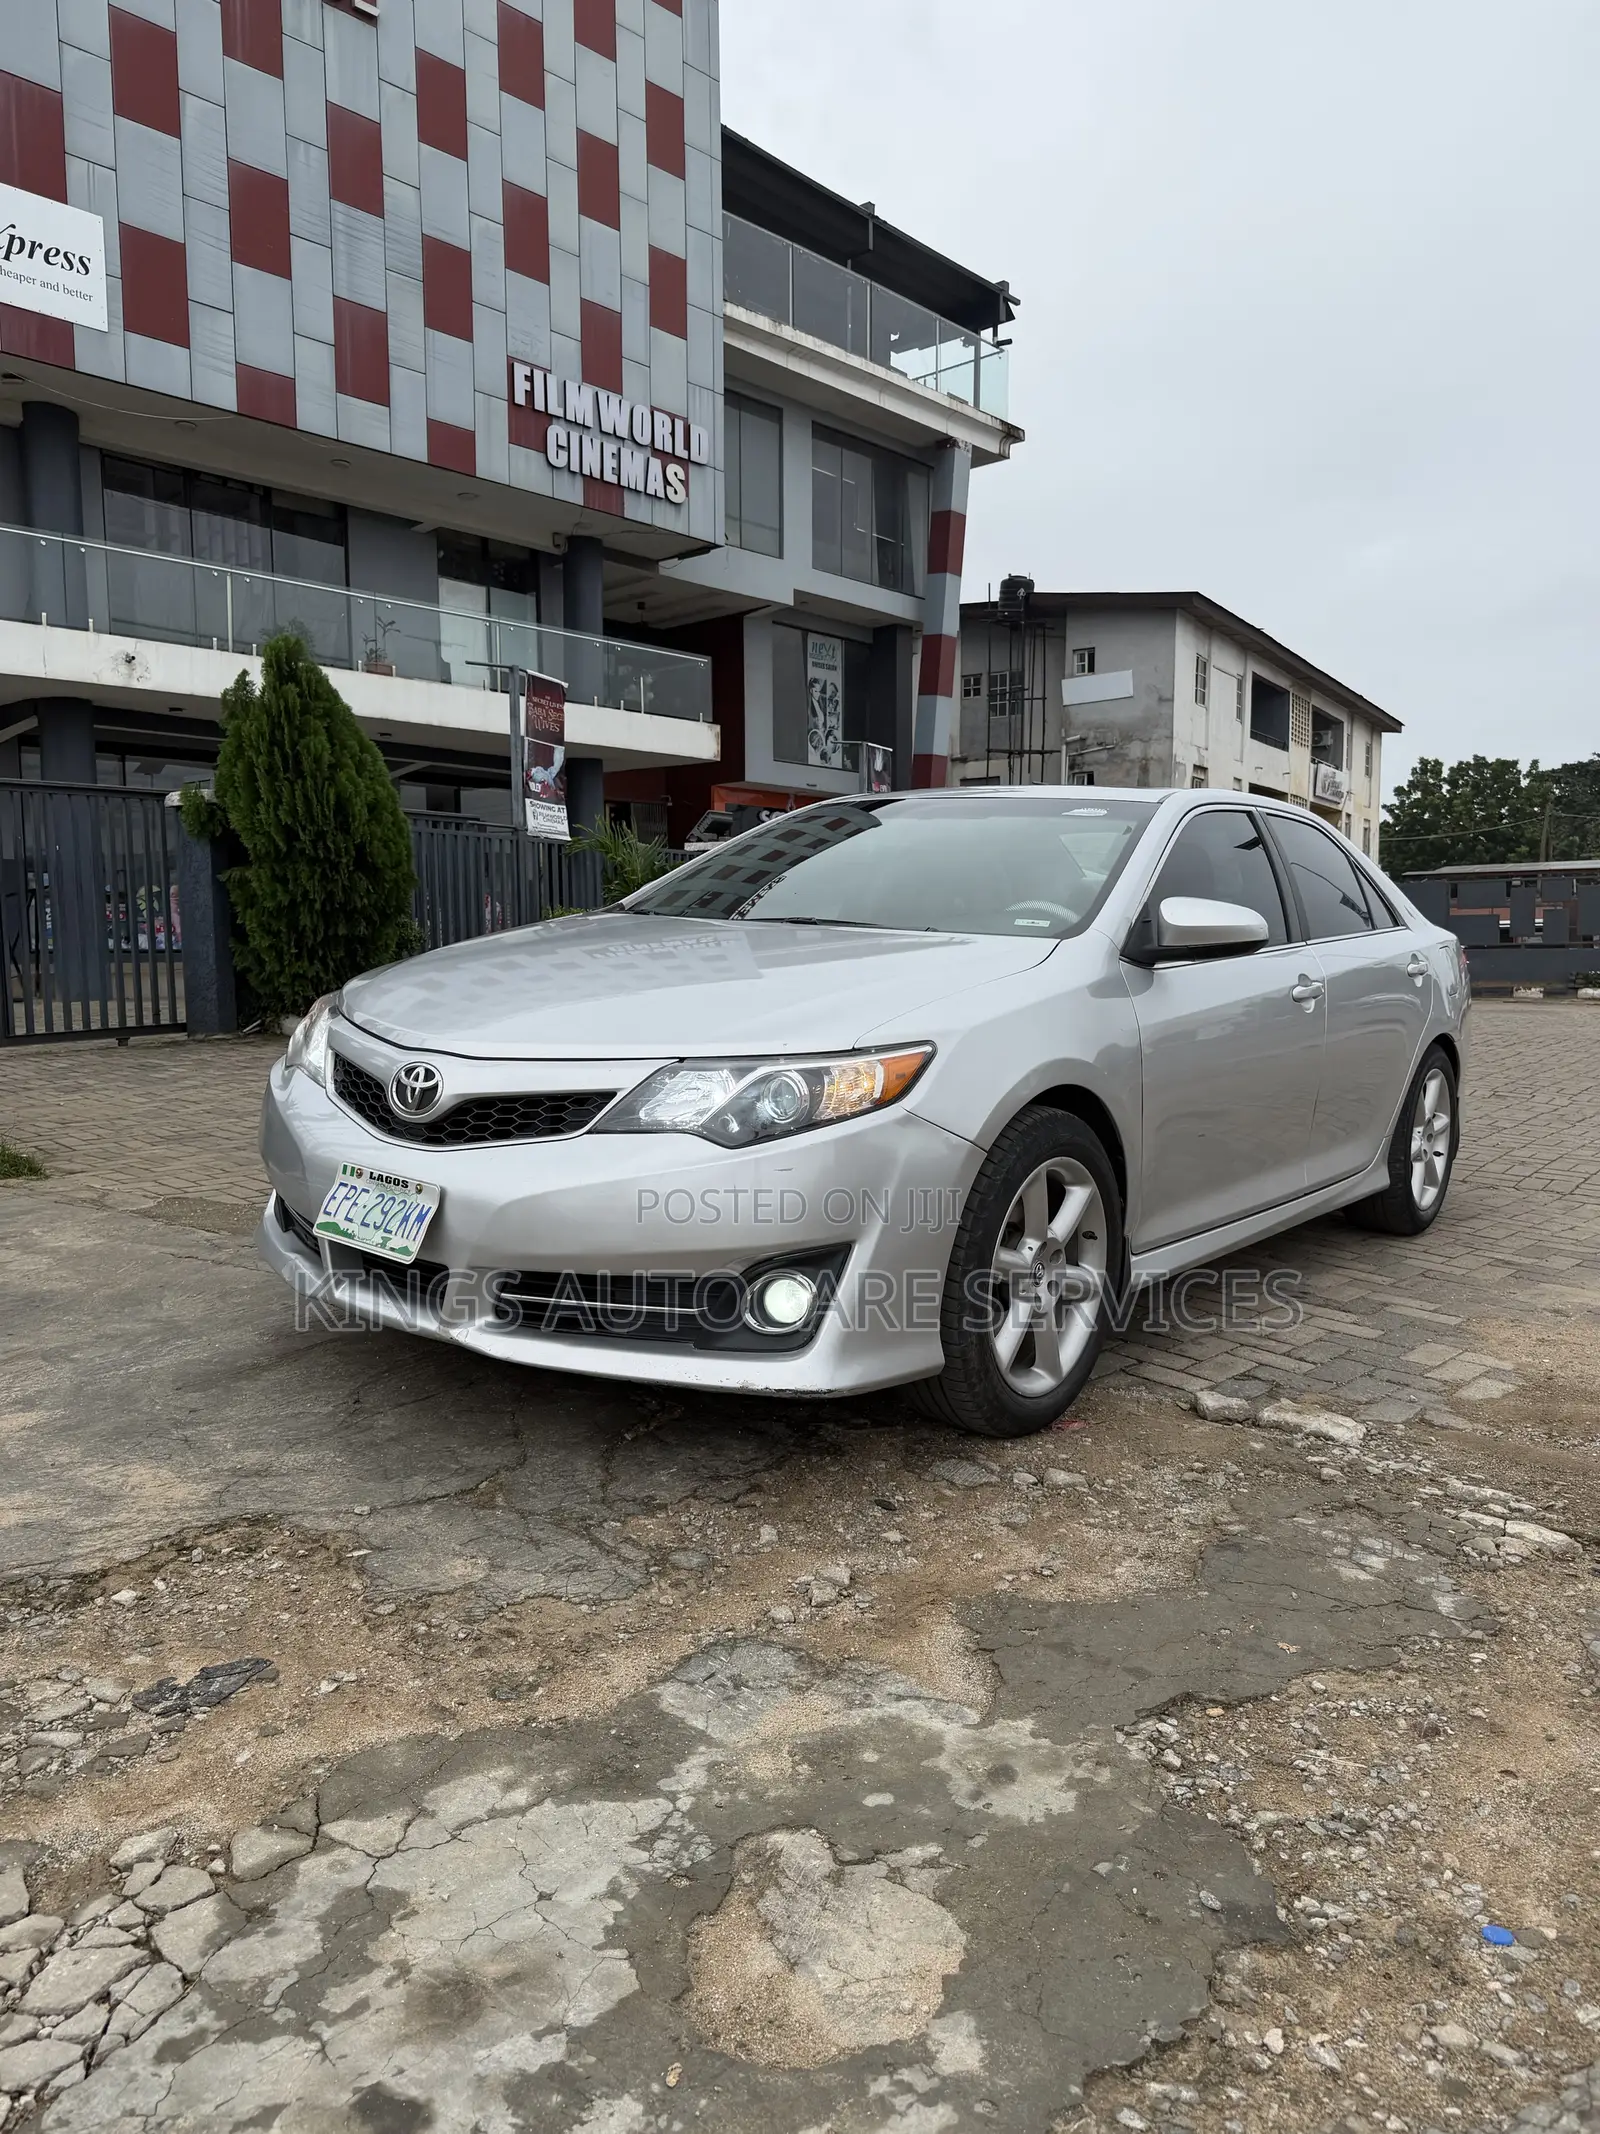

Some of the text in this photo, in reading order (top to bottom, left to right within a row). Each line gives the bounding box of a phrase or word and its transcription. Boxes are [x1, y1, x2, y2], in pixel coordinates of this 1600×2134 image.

[40, 280, 60, 292] and
[62, 284, 94, 302] better
[547, 424, 688, 504] CINEMAS
[369, 1171, 409, 1189] LAGOS
